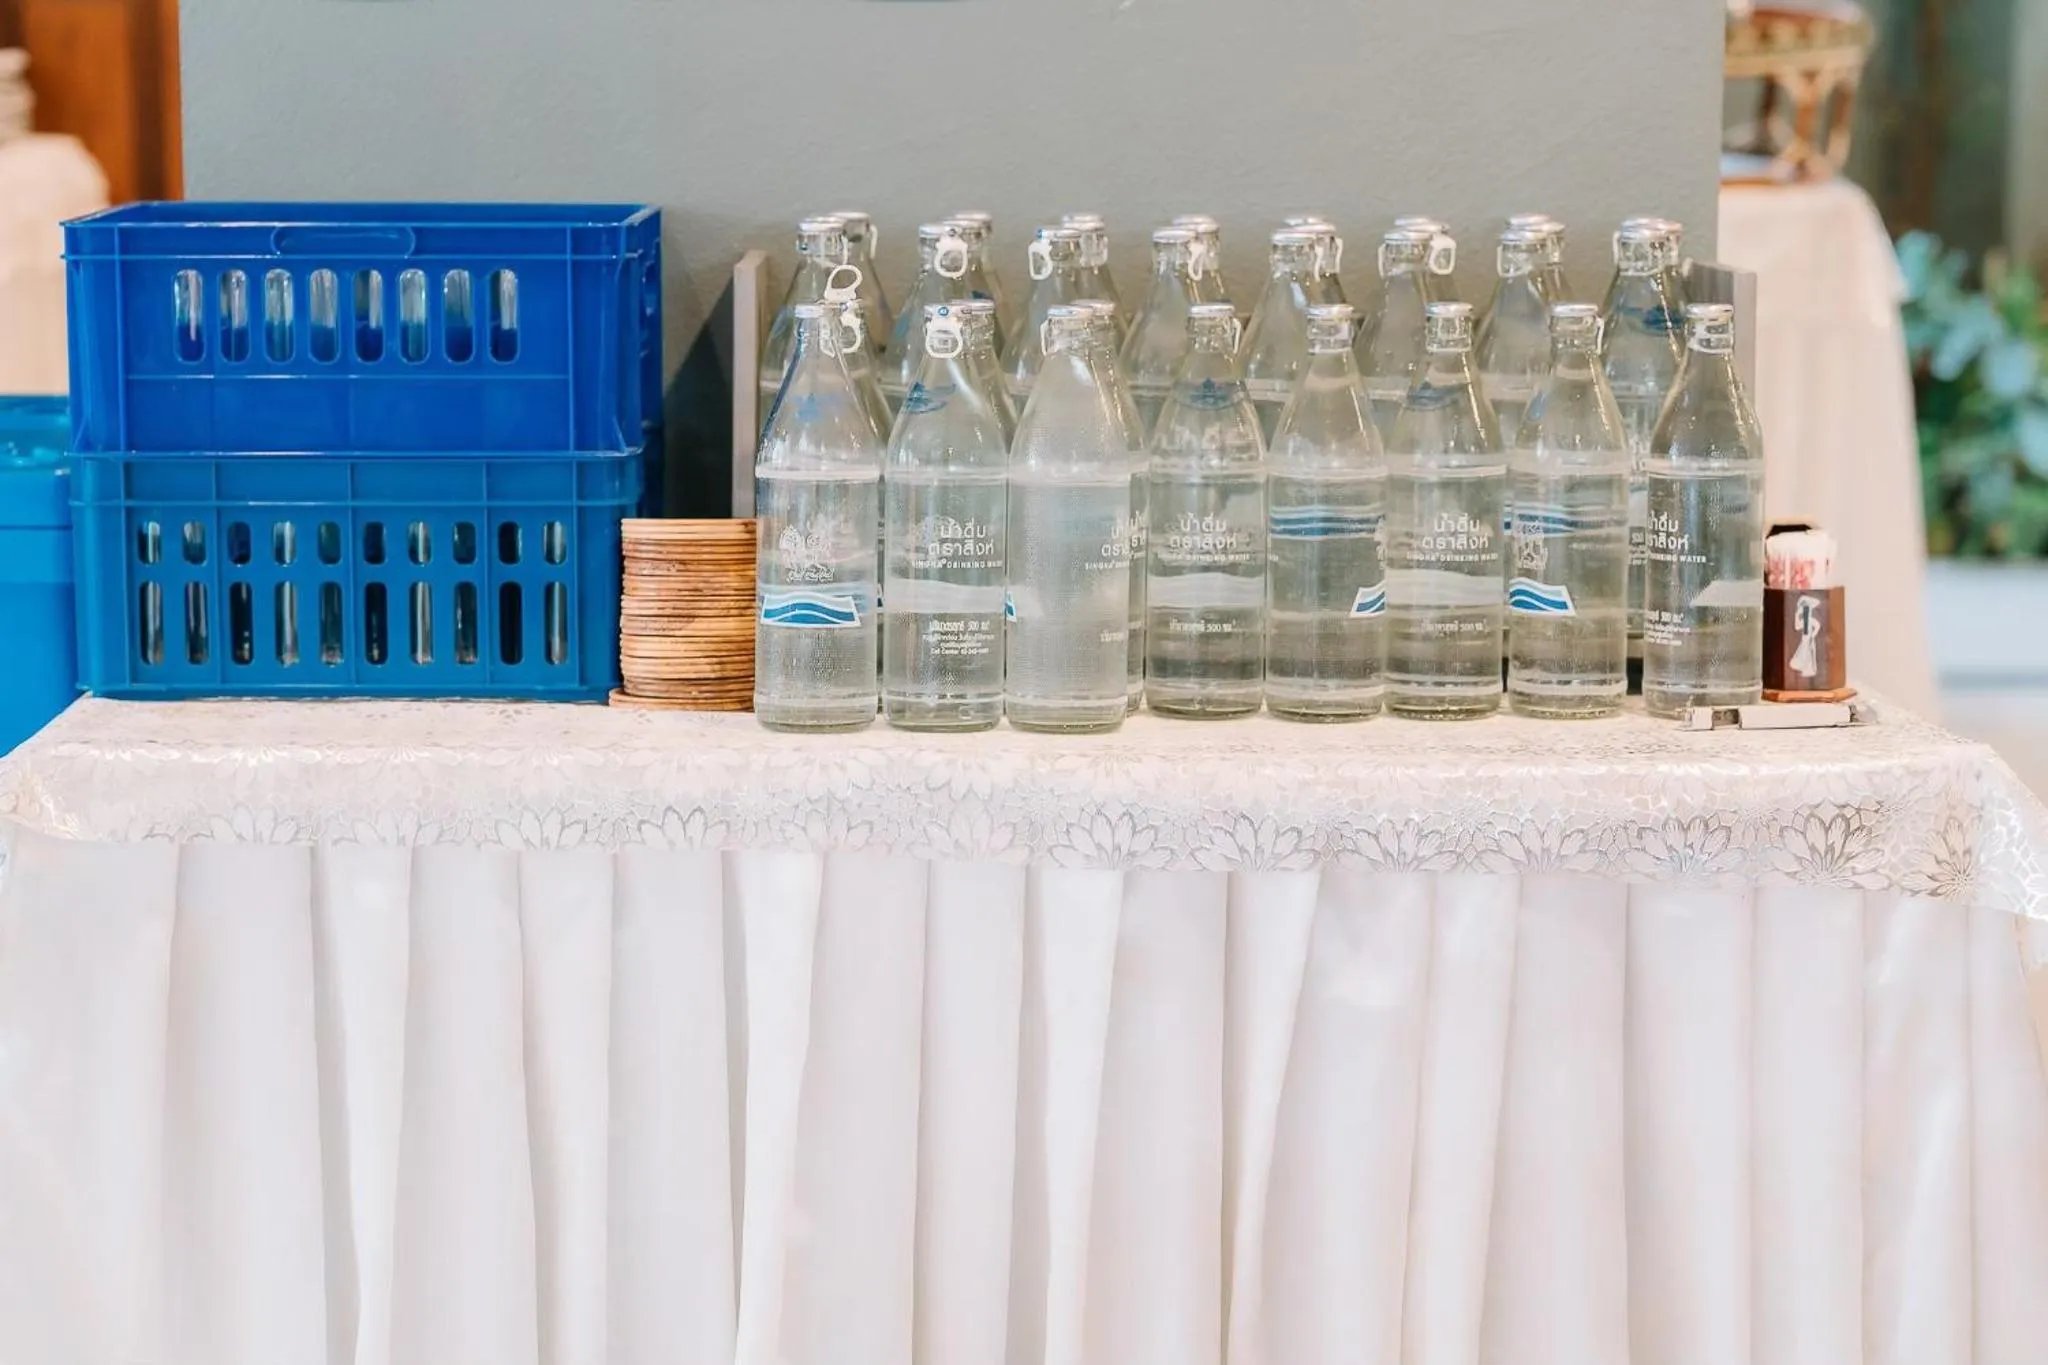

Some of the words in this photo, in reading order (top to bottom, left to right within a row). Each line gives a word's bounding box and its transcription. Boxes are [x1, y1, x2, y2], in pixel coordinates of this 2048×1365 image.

[940, 516, 986, 538] น้ำดื่ม
[1180, 512, 1227, 532] น้ำดื่ม
[1434, 512, 1480, 532] น้ำดื่ม
[928, 538, 994, 555] ตราสิงห์
[1170, 533, 1237, 549] ตราสิงห์
[1422, 533, 1489, 549] ตราสิงห์
[1680, 555, 1707, 563] WATER
